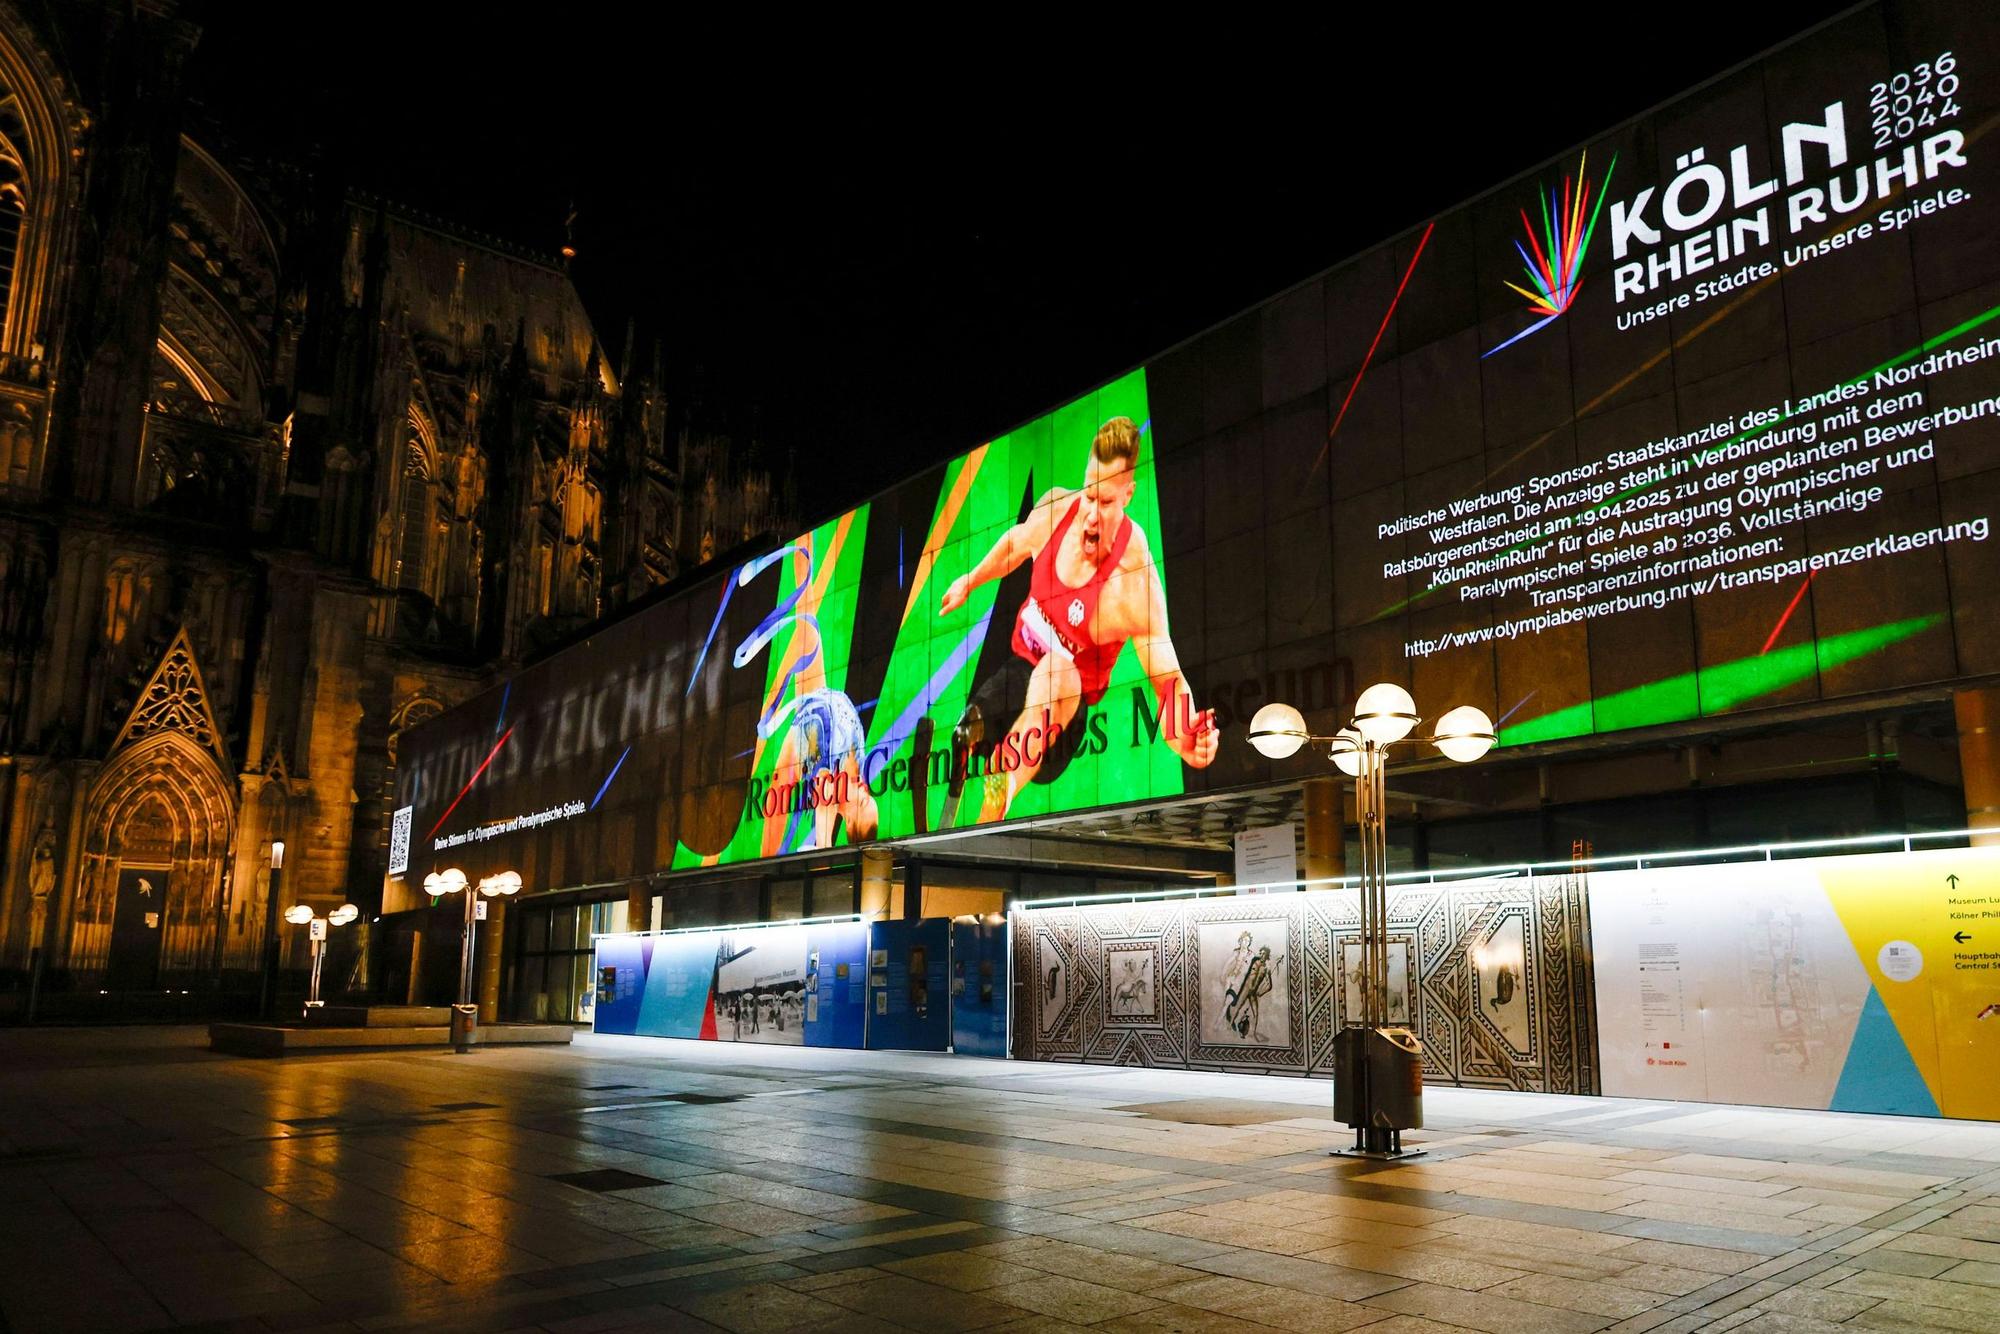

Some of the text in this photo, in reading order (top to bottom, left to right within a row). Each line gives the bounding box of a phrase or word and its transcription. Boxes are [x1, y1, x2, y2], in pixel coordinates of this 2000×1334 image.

[1869, 51, 1957, 108] 2036
[1871, 73, 1960, 129] 2040
[1873, 97, 1962, 150] 2044
[1609, 100, 1848, 261] KÖLN
[1612, 129, 1968, 304] RHEIN RUHR
[1615, 187, 1972, 332] Unsere Städte. Unsere Spiele.
[1378, 508, 1447, 540] Politische
[1448, 485, 1525, 518] Werbung:
[1528, 460, 1603, 496] Sponsor:
[1607, 415, 1735, 471] Staatskanzlei
[1739, 407, 1780, 431] des
[1784, 379, 1870, 418] Landes
[1383, 522, 1541, 579] Ratsbürgerentscheid
[1544, 516, 1572, 536] am
[1575, 489, 1671, 527] 19.04.2025
[1675, 480, 1699, 499] zu
[1703, 469, 1739, 491] der
[1743, 436, 1858, 486] geplanten
[1429, 391, 1923, 545] Westfalen. Die Anzeige steht in Verbindung mit dem
[1558, 535, 1582, 555] für
[1586, 526, 1615, 547] die
[1618, 496, 1732, 539] Austragung
[1737, 457, 1881, 508] Olympischer
[1885, 440, 1934, 469] und
[1404, 517, 1990, 658] http://www.olympiabewerbung.nrw/transparenzerklaerung
[1460, 486, 1883, 602] Paralympischer Spiele ab 2036. Vollständige
[1530, 535, 1784, 608] Transparenzinformationen:
[434, 799, 587, 851] Deine Stimme für Olympische und Paralympische Spiele.
